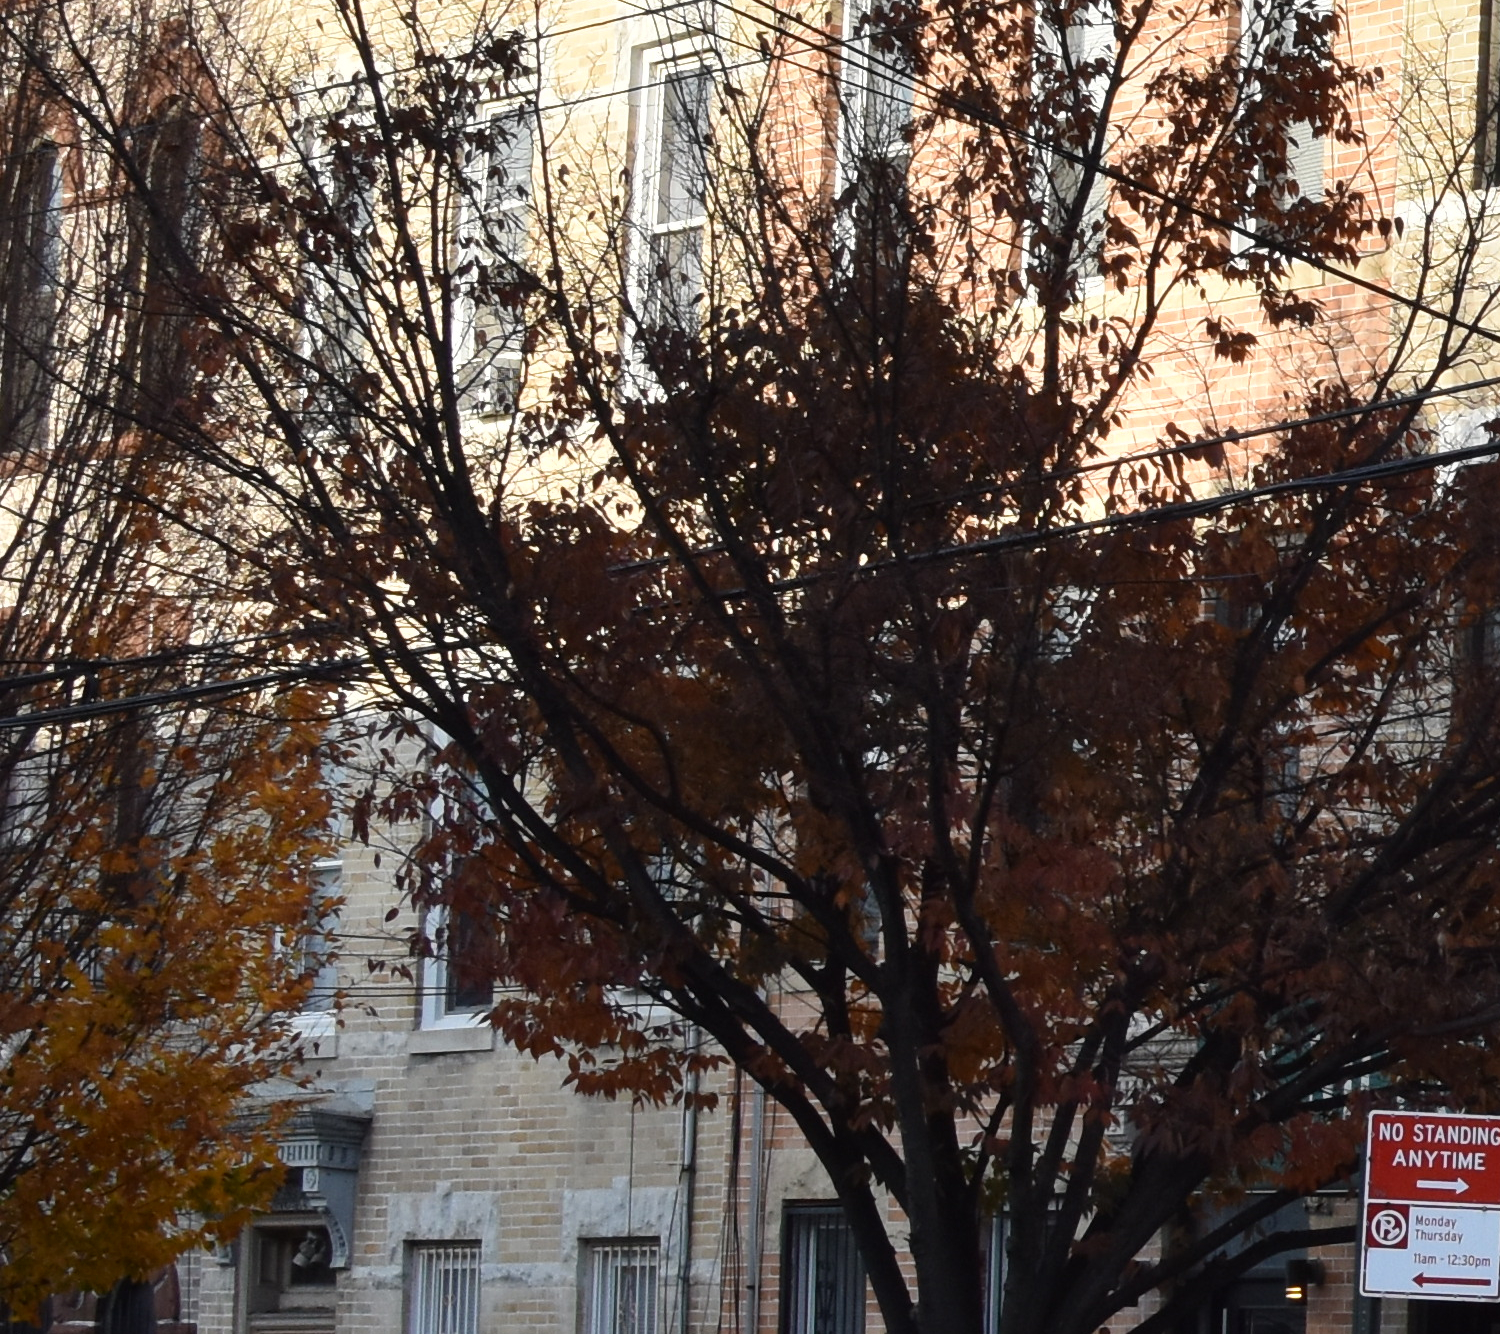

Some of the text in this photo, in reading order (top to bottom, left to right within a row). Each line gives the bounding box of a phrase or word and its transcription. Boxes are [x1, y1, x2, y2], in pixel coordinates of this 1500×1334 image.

[1379, 1123, 1500, 1145] NO STANDING
[1392, 1149, 1486, 1170] ANYTIME
[1415, 1215, 1457, 1228] Monday
[1415, 1229, 1463, 1243] Thursday
[1413, 1253, 1436, 1264] 11am
[1448, 1254, 1491, 1268] 12:30pm
